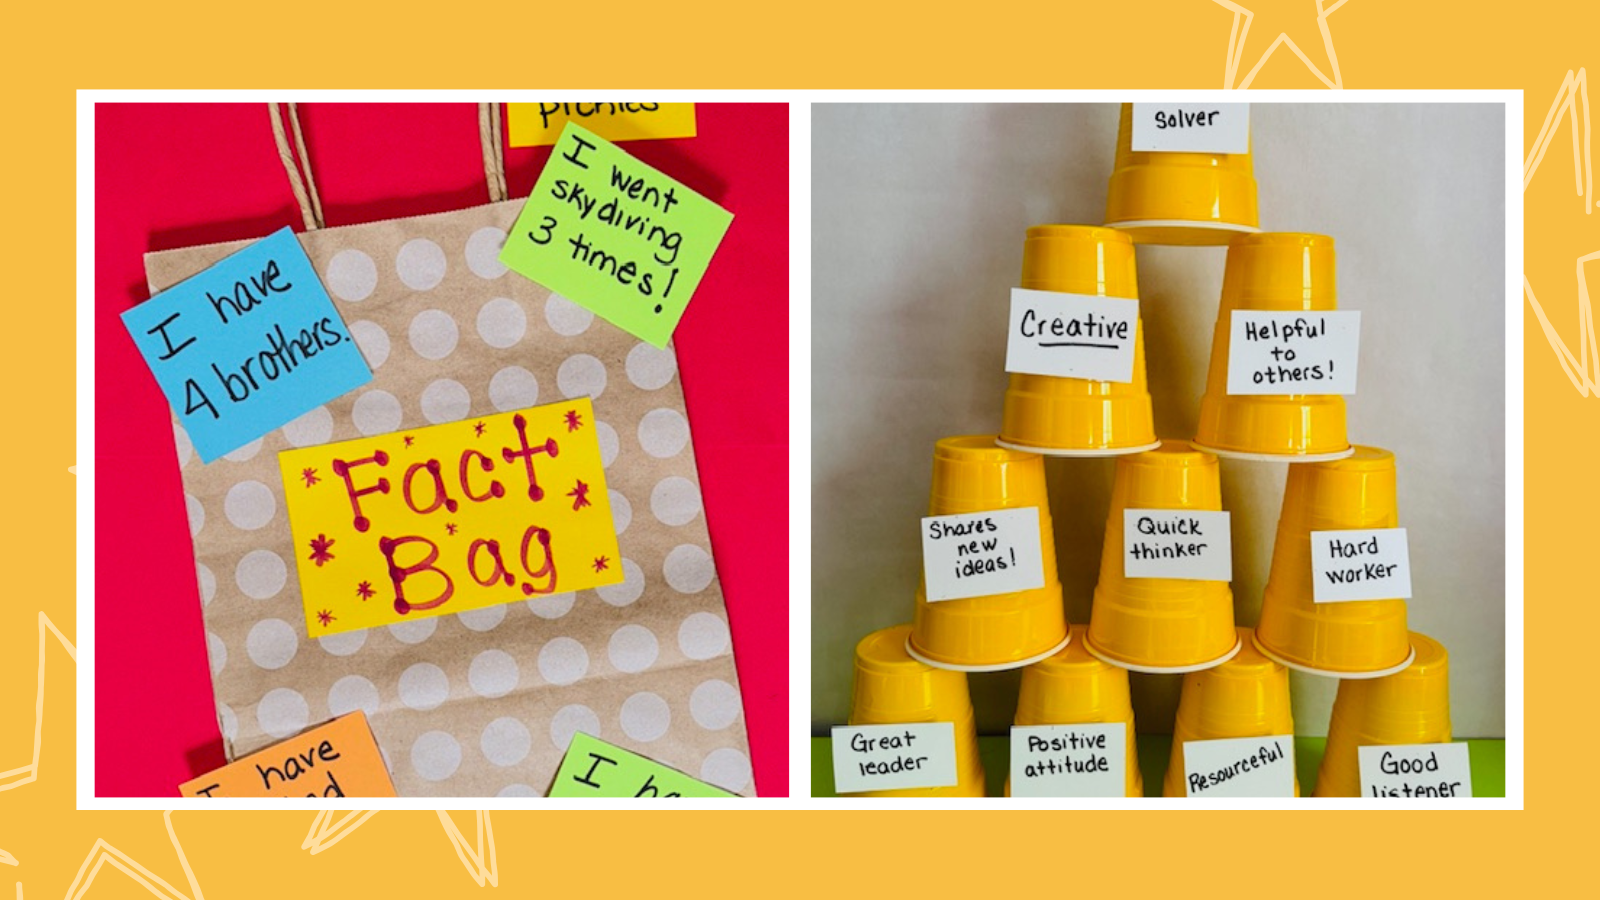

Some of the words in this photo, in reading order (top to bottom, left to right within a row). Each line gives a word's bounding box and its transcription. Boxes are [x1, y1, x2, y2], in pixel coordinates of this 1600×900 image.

[562, 134, 597, 170] I
[610, 165, 679, 213] went
[551, 179, 683, 266] skydiving
[528, 216, 558, 245] 3
[568, 233, 679, 314] times!
[147, 312, 197, 361] I
[206, 259, 293, 324] have
[1020, 308, 1129, 340] Creative
[1245, 318, 1326, 341] Helpful
[1270, 347, 1296, 362] to
[184, 378, 220, 420] 4
[210, 317, 351, 403] brothers.
[1252, 360, 1335, 384] others!
[332, 413, 560, 534] Fact
[929, 516, 998, 540] Shares
[1137, 516, 1204, 536] Quick
[957, 536, 998, 557] new
[1130, 541, 1208, 561] thinker
[1328, 535, 1379, 559] Hard
[378, 524, 558, 616] Bag
[955, 547, 1017, 579] ideas!
[1325, 563, 1398, 585] worker
[850, 730, 917, 754] Great
[1027, 732, 1107, 753] Positive
[255, 739, 341, 790] have
[572, 752, 618, 789] I
[858, 754, 929, 777] leader
[1024, 754, 1110, 778] attitude
[1188, 741, 1285, 794] Resourceful
[1380, 751, 1440, 775] Good
[1371, 780, 1462, 798] listener
